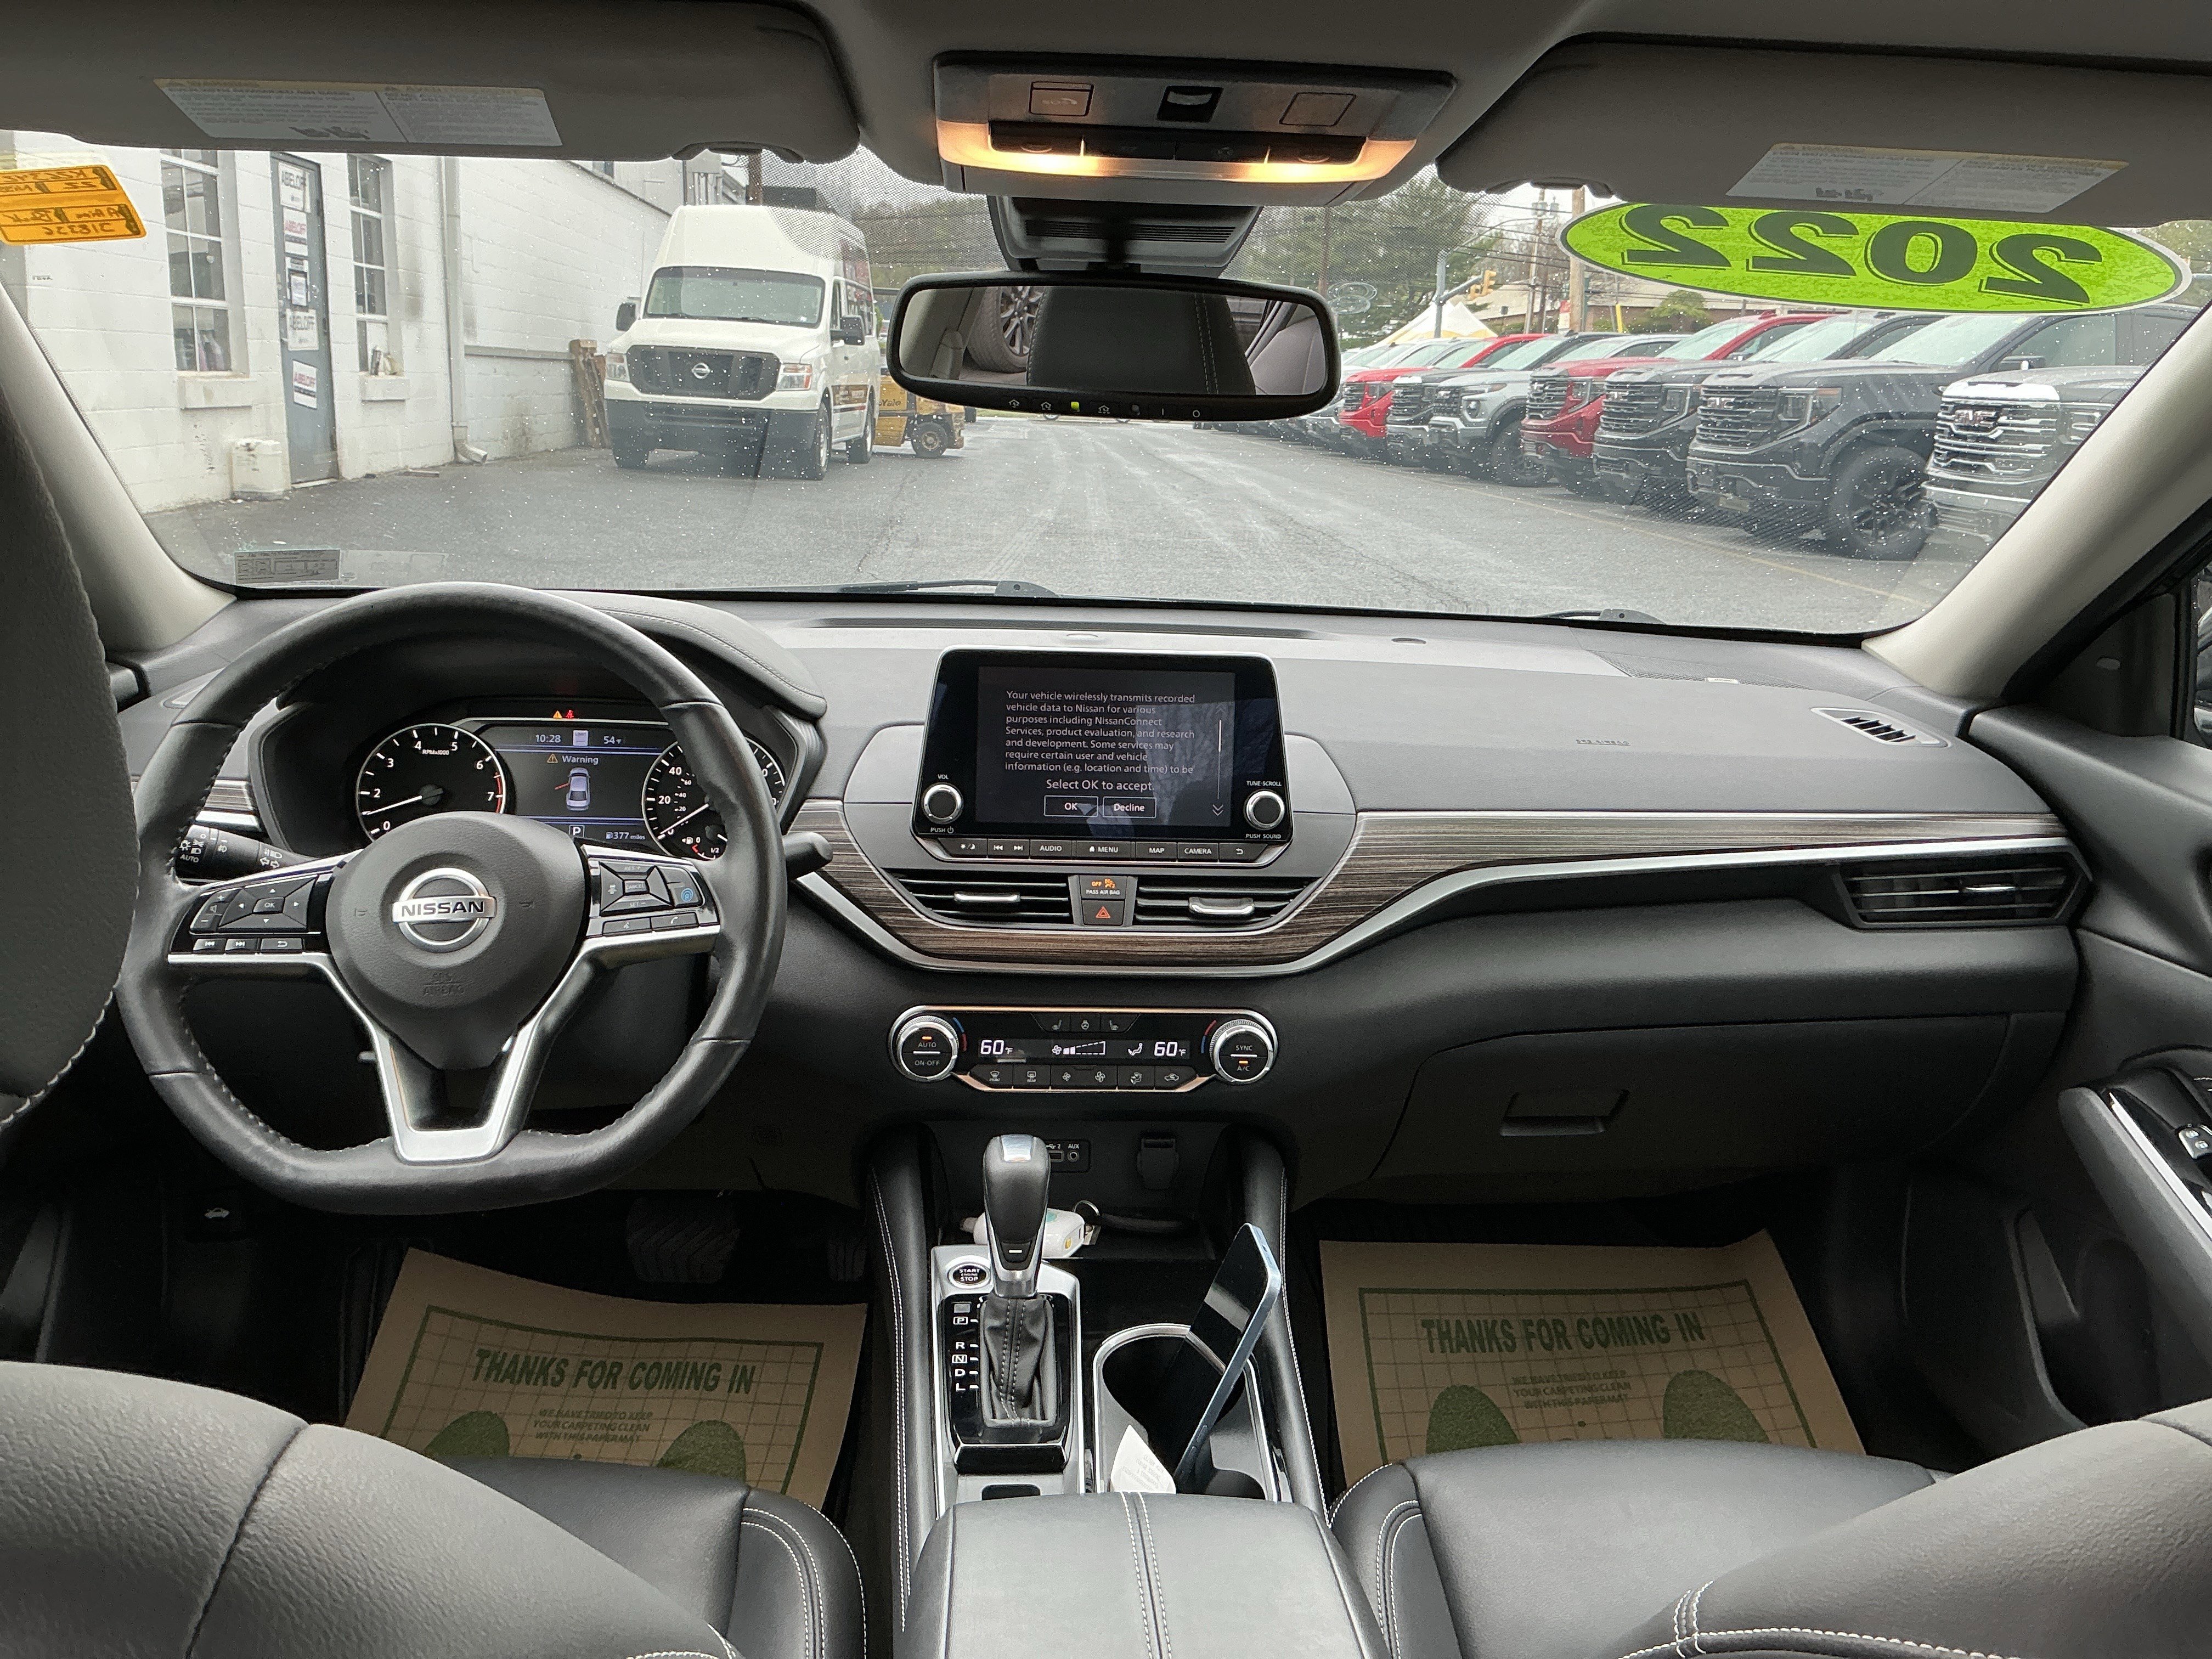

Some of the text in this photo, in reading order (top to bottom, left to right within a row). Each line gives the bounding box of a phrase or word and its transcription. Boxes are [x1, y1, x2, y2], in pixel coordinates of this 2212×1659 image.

[1007, 691, 1195, 703] Your vehicle wirelessly transmits recorded
[1006, 703, 1038, 712] vehicle
[1040, 704, 1061, 712] data
[1075, 704, 1104, 713] Nissan
[1107, 704, 1120, 713] for
[1122, 706, 1156, 714] various
[1006, 715, 1163, 726] purposes including NissanConnect
[1006, 727, 1195, 739] Services, product evaluation, and research
[535, 734, 561, 743] 10:28
[414, 741, 422, 750] 4
[451, 742, 458, 751] 5
[1005, 738, 1023, 747] and
[1090, 740, 1116, 749] Some
[1118, 741, 1153, 749] services
[1155, 742, 1175, 752] may
[562, 755, 599, 765] Warning
[1005, 751, 1148, 761] require certain user and vehicle
[387, 758, 394, 768] 3
[476, 760, 483, 770] 6
[668, 766, 682, 776] 40
[1005, 762, 1194, 775] information (e.g. location and time) to be
[1046, 779, 1155, 793] Select OK to accept.
[373, 788, 381, 798] 2
[487, 791, 494, 801] 7
[658, 795, 671, 804] 20
[1064, 802, 1078, 810] OK
[1113, 803, 1146, 812] Decline
[383, 821, 391, 830] 0
[573, 826, 582, 836] P
[613, 831, 630, 840] 377
[180, 854, 199, 863] AUTO
[401, 900, 484, 917] NISSAN
[1421, 1311, 1706, 1354] THANKS FOR COMING IN
[955, 1341, 966, 1350] R
[472, 1347, 757, 1395] THANKS FOR COMING IN
[955, 1368, 966, 1377] D
[956, 1383, 966, 1391] L
[1513, 1387, 1541, 1397] YOUR
[1599, 1381, 1632, 1392] CLEAN
[533, 1419, 651, 1432] YOUR CARPETING CLEAN
